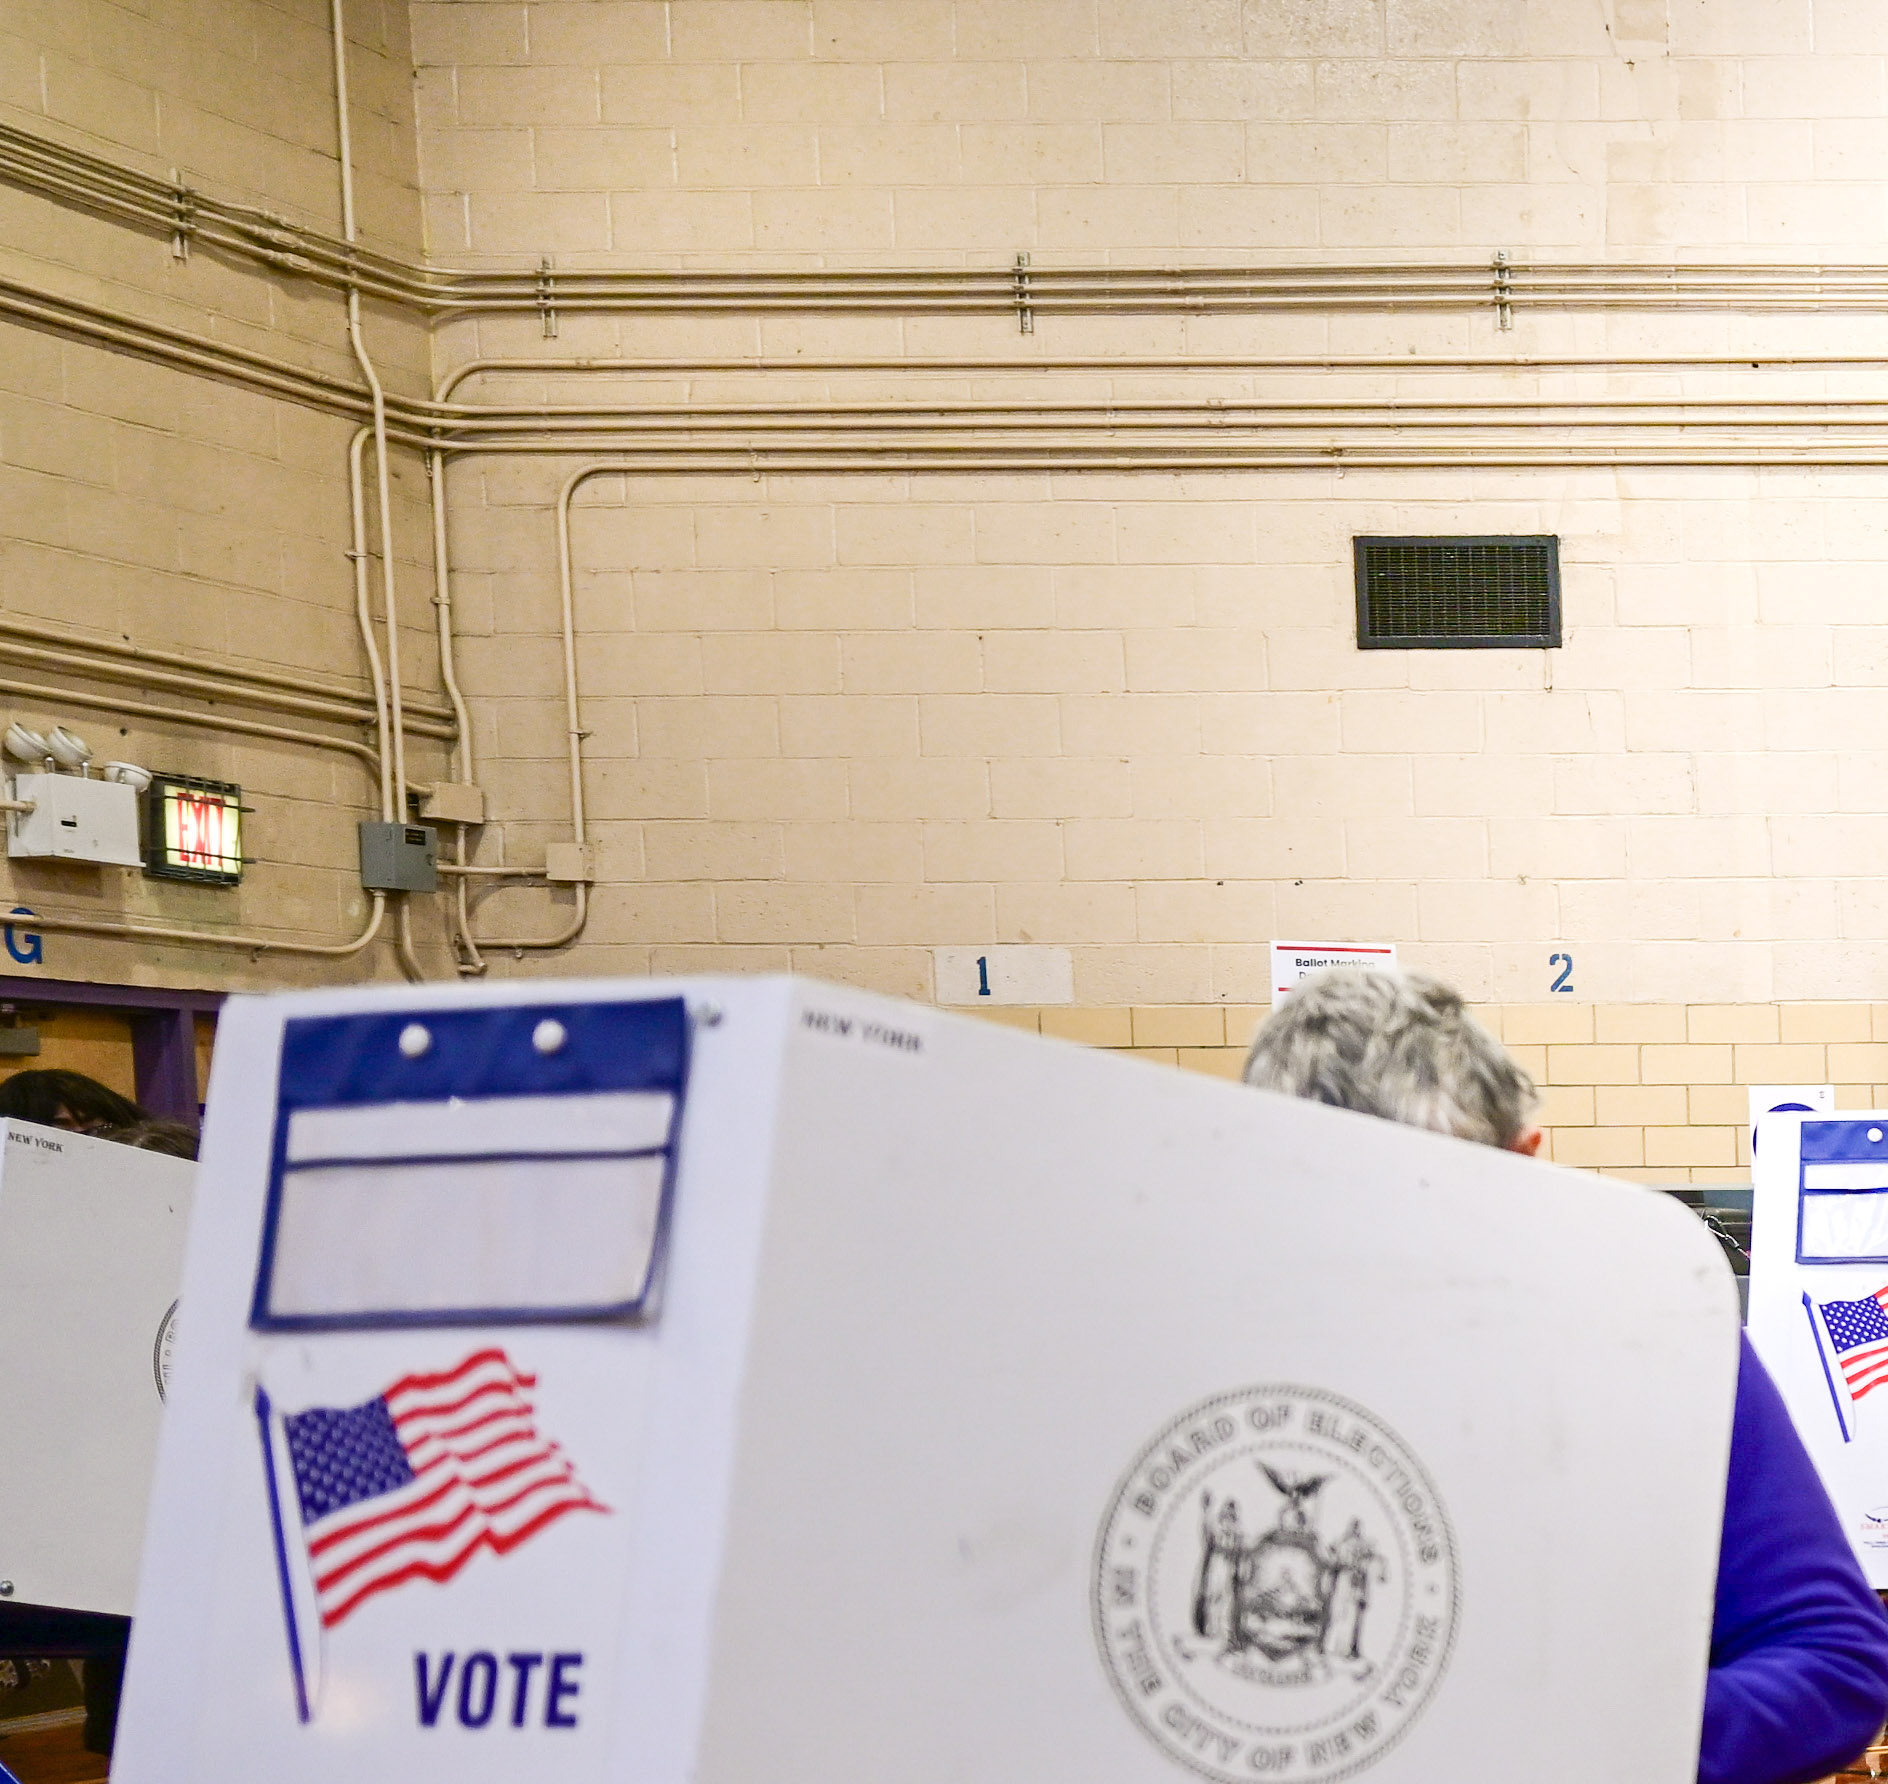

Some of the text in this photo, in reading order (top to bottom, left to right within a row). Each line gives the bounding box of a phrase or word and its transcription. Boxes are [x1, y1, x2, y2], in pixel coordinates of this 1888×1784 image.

[176, 792, 226, 867] EXIT
[4, 907, 42, 964] G
[1295, 958, 1328, 967] Ballot
[977, 956, 991, 996] 1
[1549, 953, 1574, 993] 2
[8, 1132, 64, 1152] NEW YORK
[1134, 1404, 1440, 1565] BOARD OF ELECTIONS
[413, 1651, 585, 1729] VOTE
[1116, 1565, 1440, 1771] IN THE CITY OF NEW YORK
